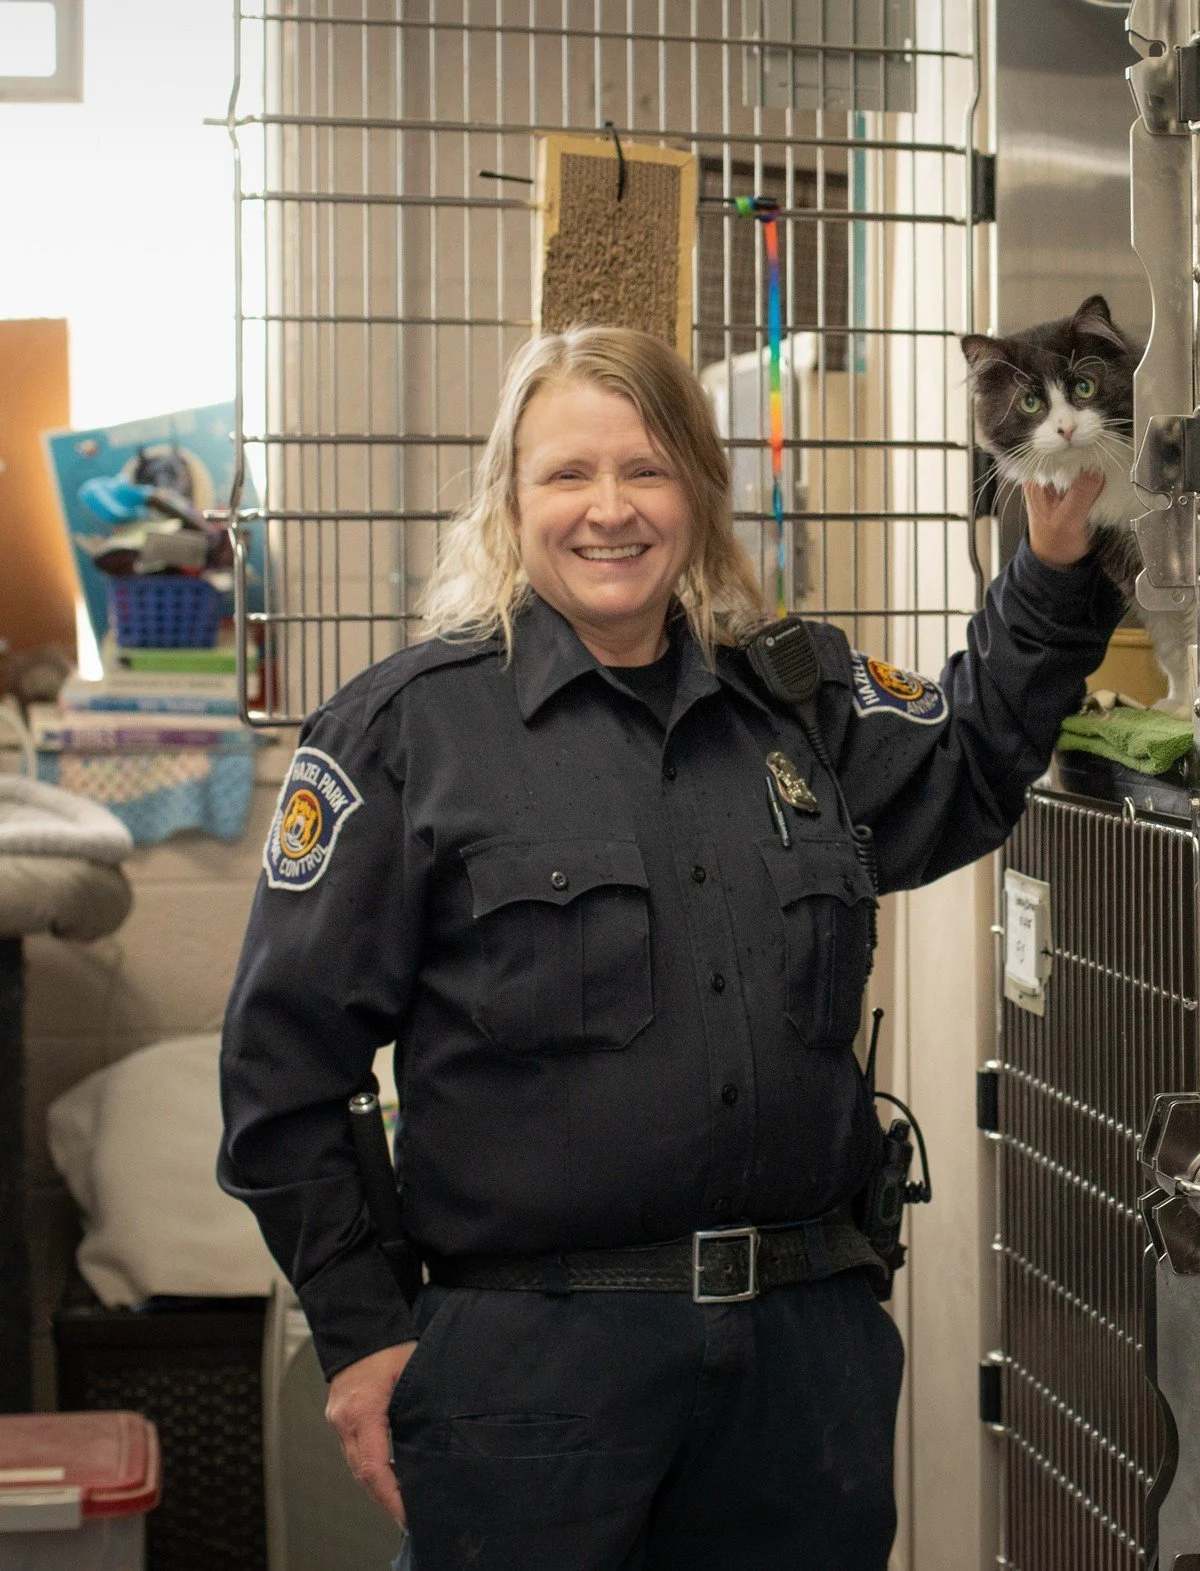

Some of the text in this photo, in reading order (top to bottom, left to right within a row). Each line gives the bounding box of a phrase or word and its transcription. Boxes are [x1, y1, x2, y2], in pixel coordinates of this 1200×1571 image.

[292, 761, 350, 814] HAZEL PARK
[279, 842, 329, 878] CONTROL
